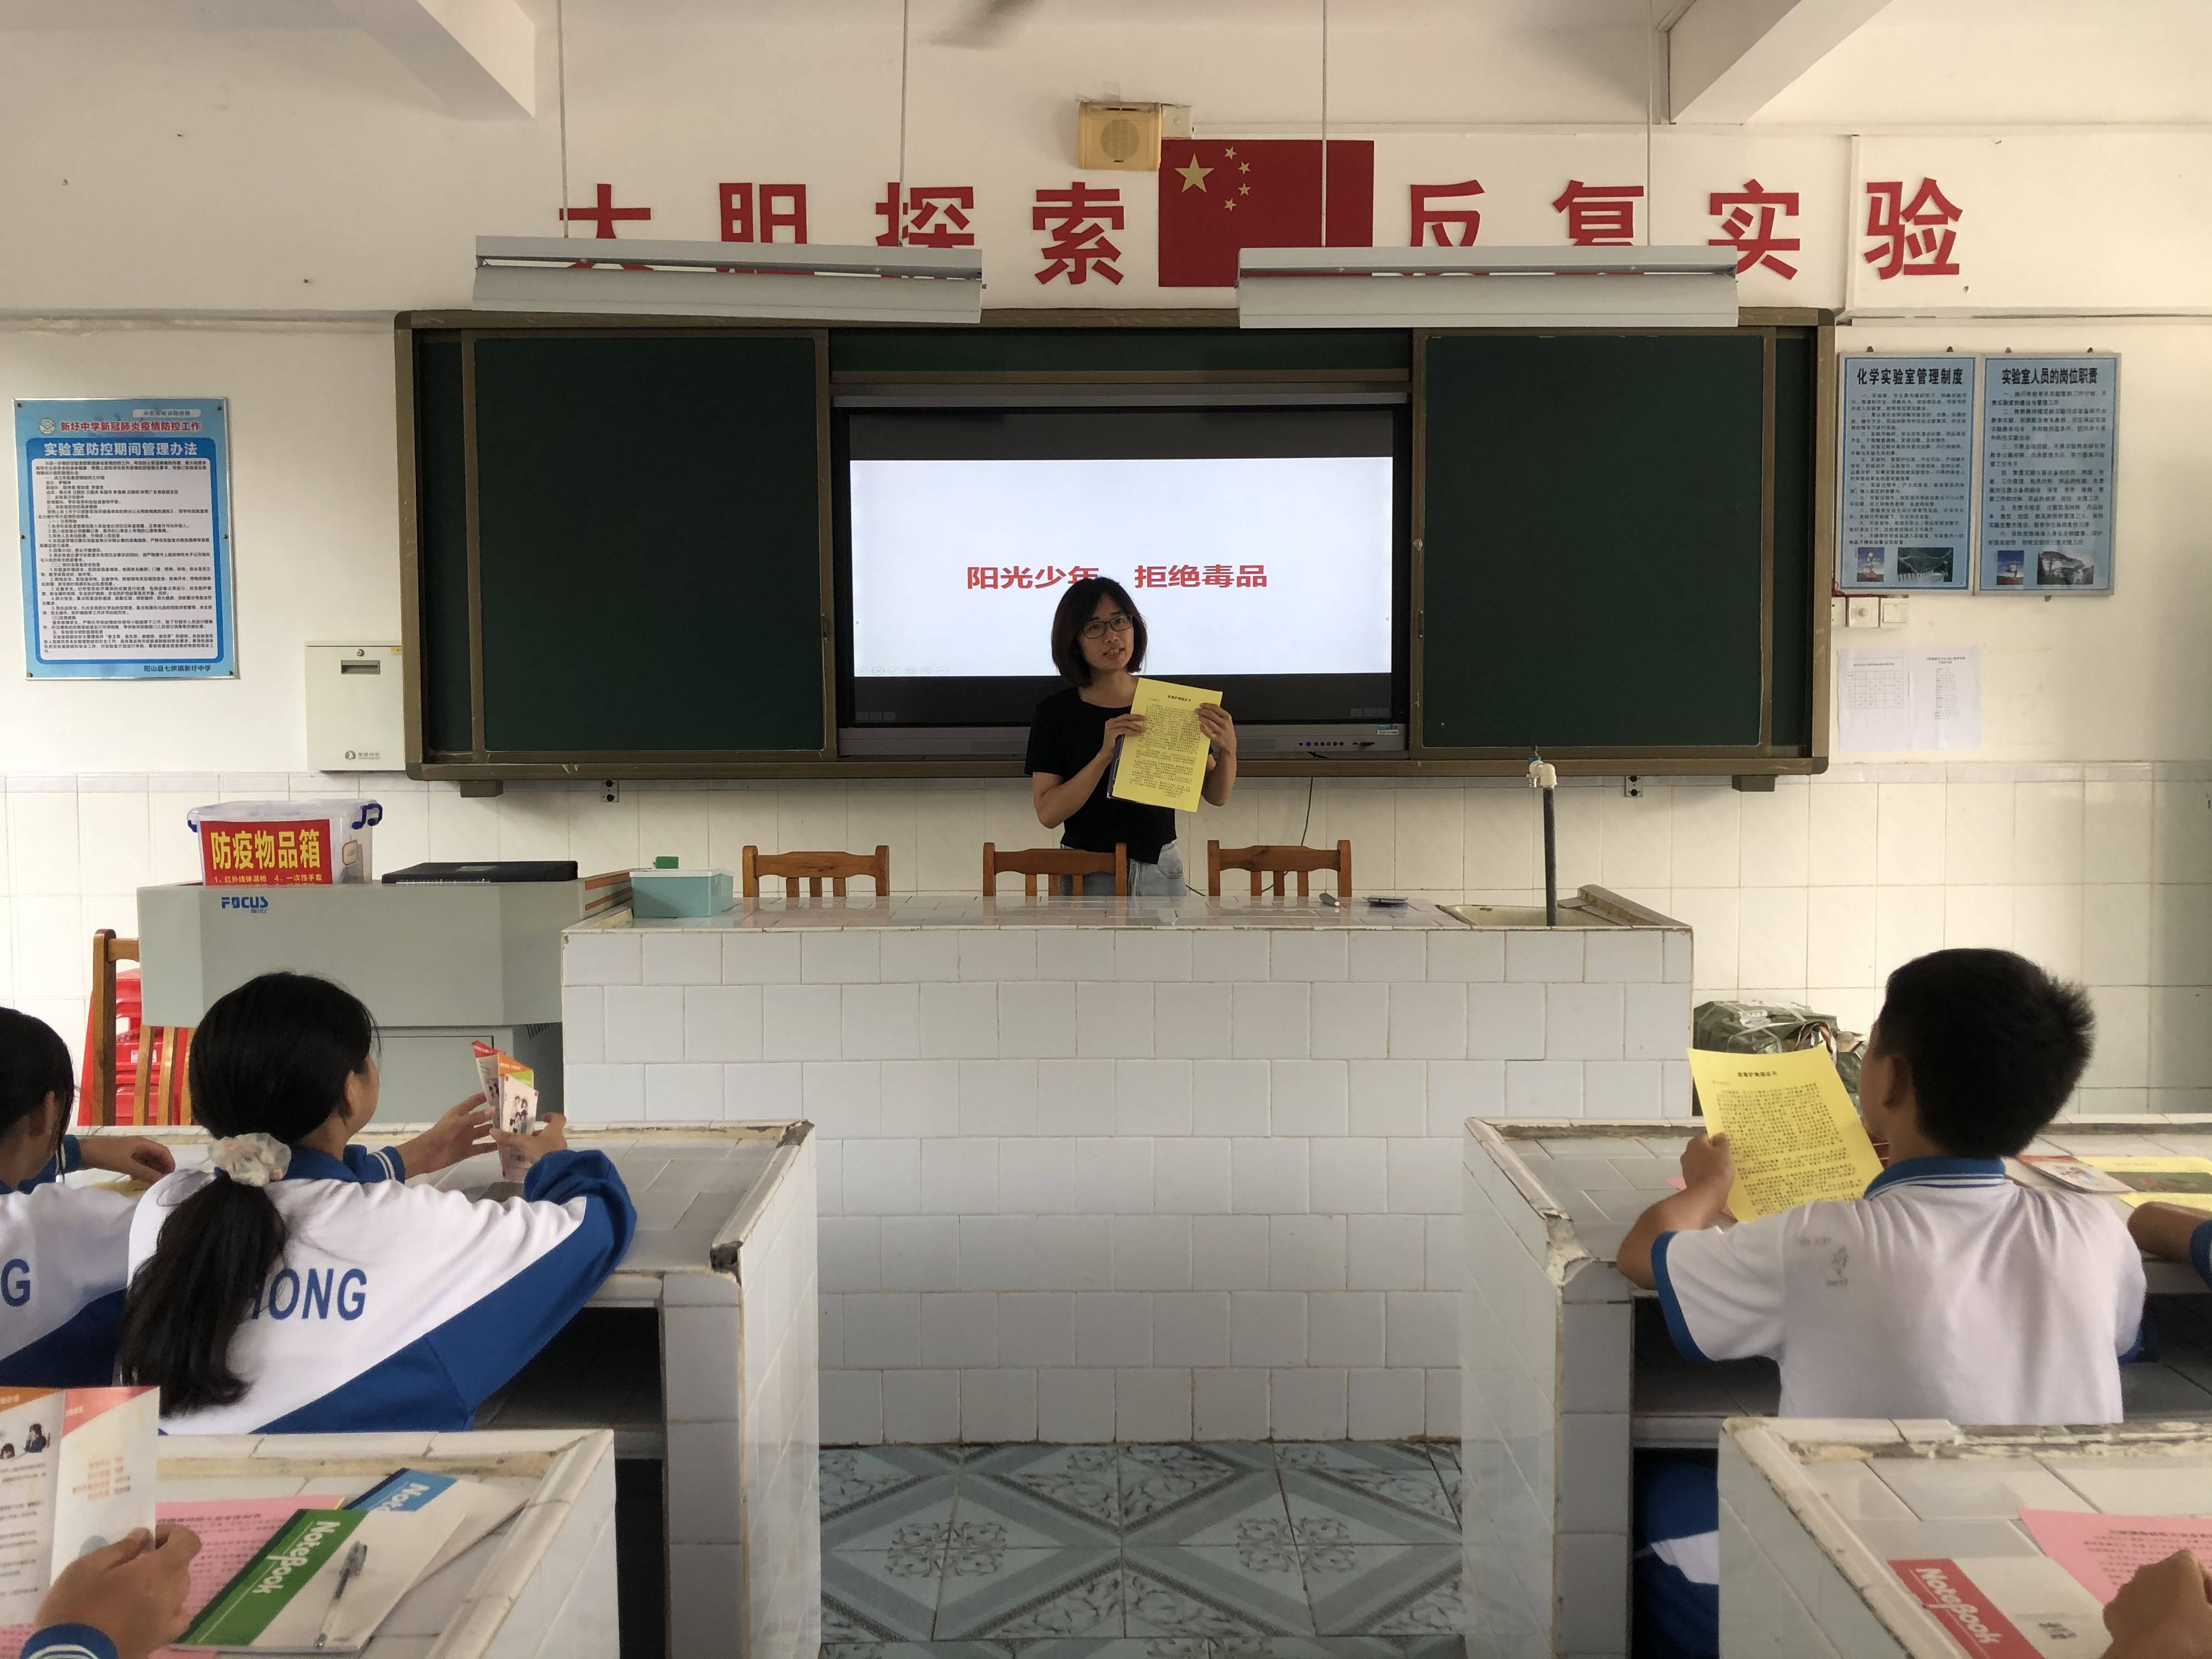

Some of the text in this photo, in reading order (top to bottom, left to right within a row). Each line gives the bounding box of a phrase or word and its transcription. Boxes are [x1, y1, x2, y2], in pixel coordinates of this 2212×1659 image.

[1857, 368, 1963, 386] 化学实验室管理制度
[2001, 367, 2098, 386] 实验室人员的岗位职责
[60, 421, 201, 432] 新圩中学新冠肺炎疫情防控工作
[44, 443, 198, 457] 实验室防控期间管理办法
[967, 564, 1267, 589] 阳光少年 拒绝毒品
[210, 828, 321, 871] 防疫物品箱
[221, 896, 269, 909] FOCUS
